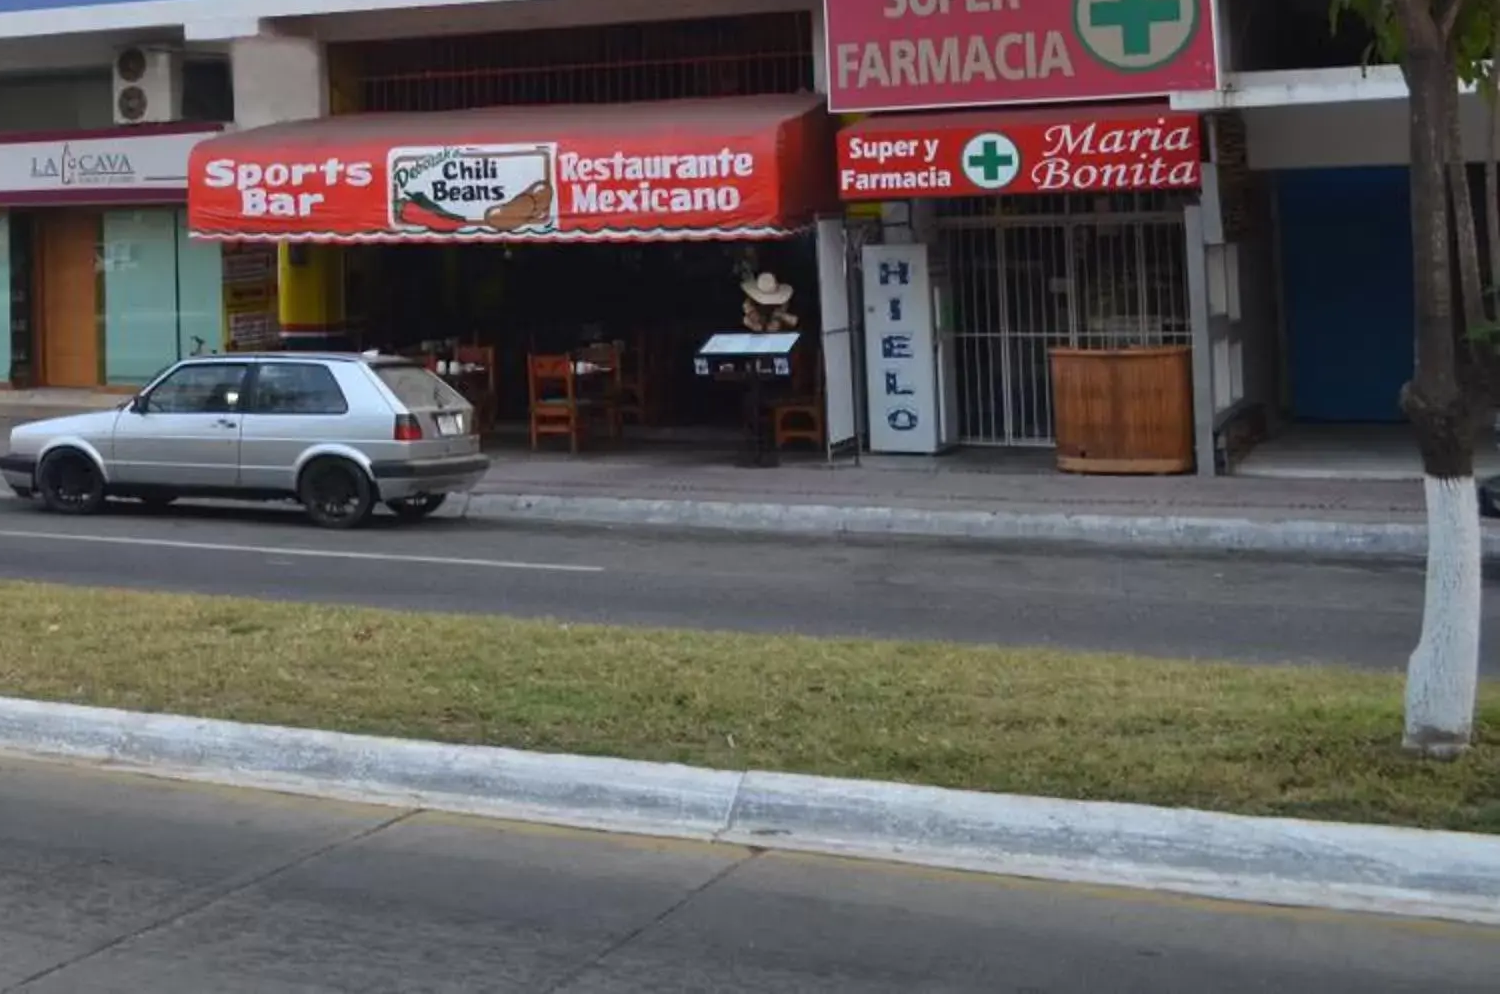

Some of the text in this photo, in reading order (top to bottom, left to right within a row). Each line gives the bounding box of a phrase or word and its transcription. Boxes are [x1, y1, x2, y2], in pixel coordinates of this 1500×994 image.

[837, 30, 1075, 88] FARMACIA
[849, 137, 939, 163] Super y
[1043, 118, 1193, 157] Maria
[31, 153, 133, 176] LA CAVA
[204, 157, 373, 190] Sports
[442, 158, 499, 180] Chili
[558, 147, 754, 182] Restaurante
[841, 168, 952, 191] Farmacia
[1031, 153, 1197, 190] Bonita
[241, 188, 324, 217] Bar
[431, 180, 505, 202] Beans
[571, 181, 741, 214] Mexicano
[879, 261, 919, 431] HIELO
